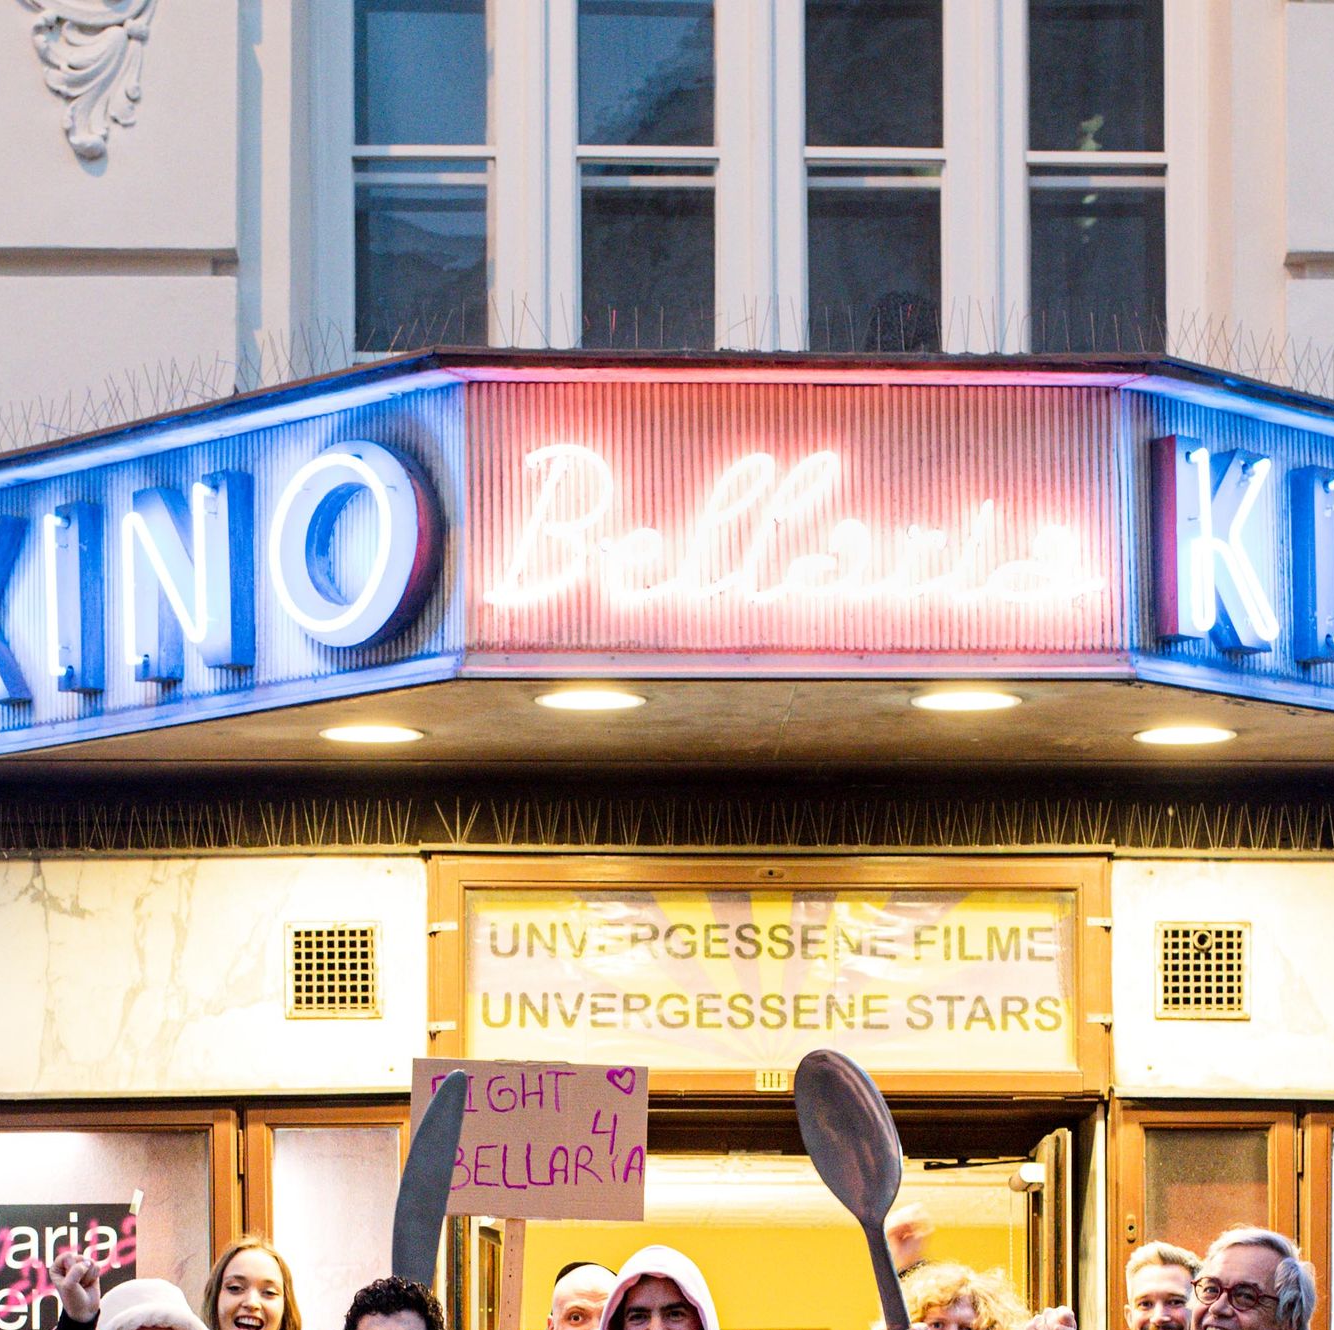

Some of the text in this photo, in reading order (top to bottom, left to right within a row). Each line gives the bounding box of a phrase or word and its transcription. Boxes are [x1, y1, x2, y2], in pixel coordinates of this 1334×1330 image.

[484, 444, 1107, 605] Bellaria
[489, 922, 1056, 962] UNVERGESSENE FILME
[481, 991, 1064, 1032] UNVERGESSENE STARS
[591, 1108, 618, 1155] 4
